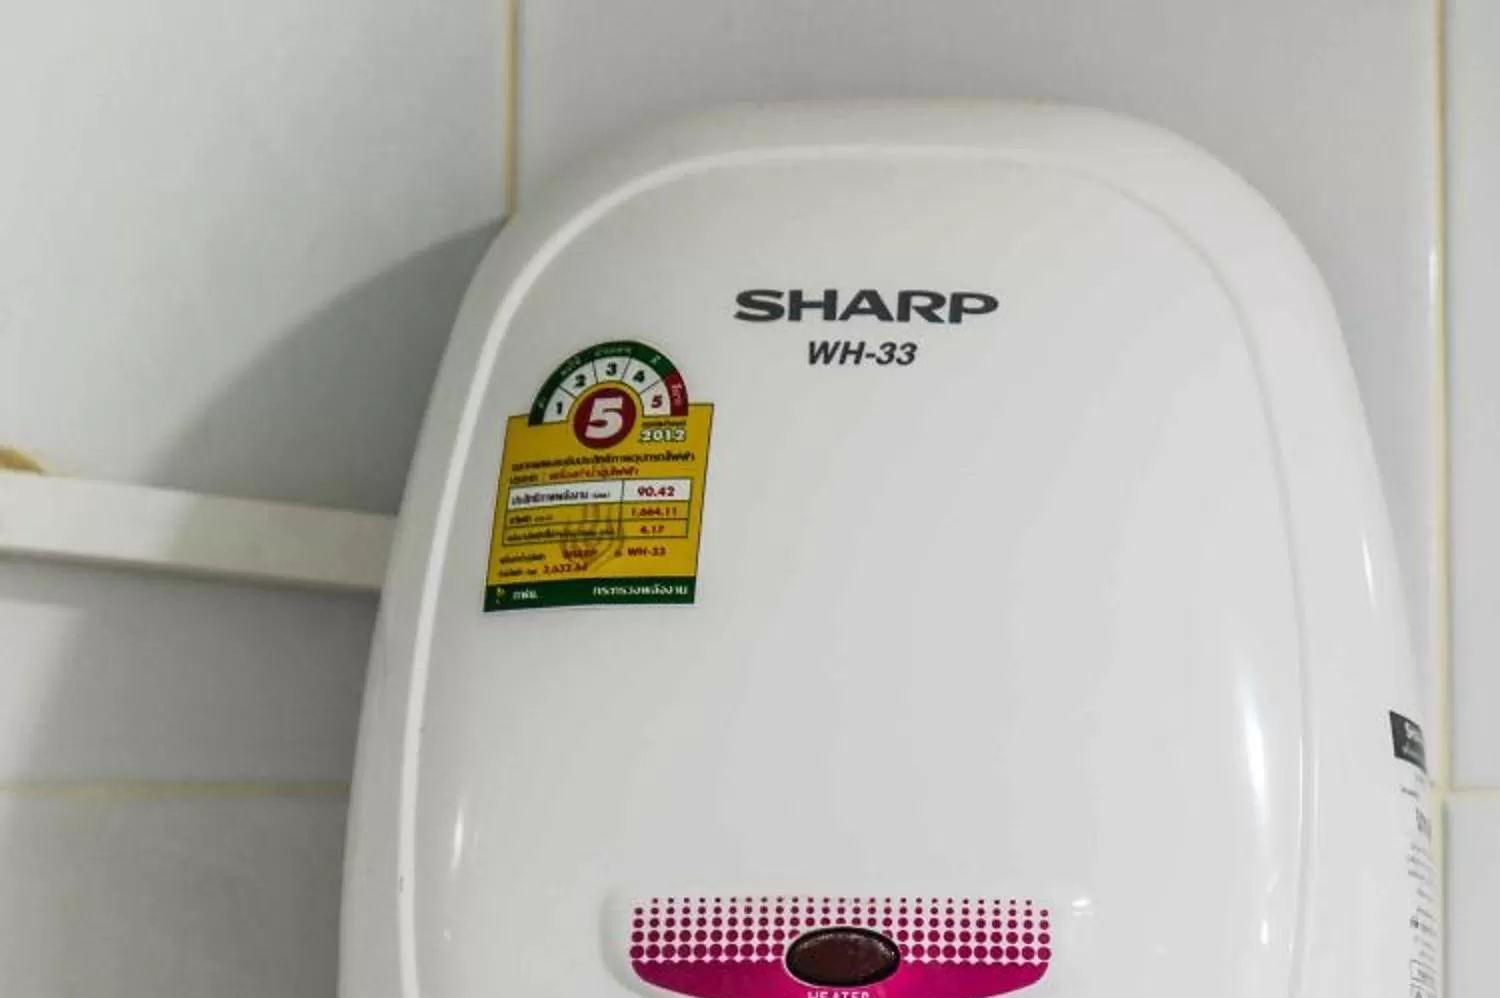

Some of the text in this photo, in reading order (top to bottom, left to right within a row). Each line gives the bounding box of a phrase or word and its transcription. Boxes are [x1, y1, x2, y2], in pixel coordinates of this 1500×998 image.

[733, 289, 999, 324] SHARP
[808, 341, 918, 366] WH-33
[556, 362, 662, 414] 1 2 3 4 5
[585, 396, 623, 439] 5
[641, 429, 685, 442] 2012
[637, 486, 675, 497] 90.42
